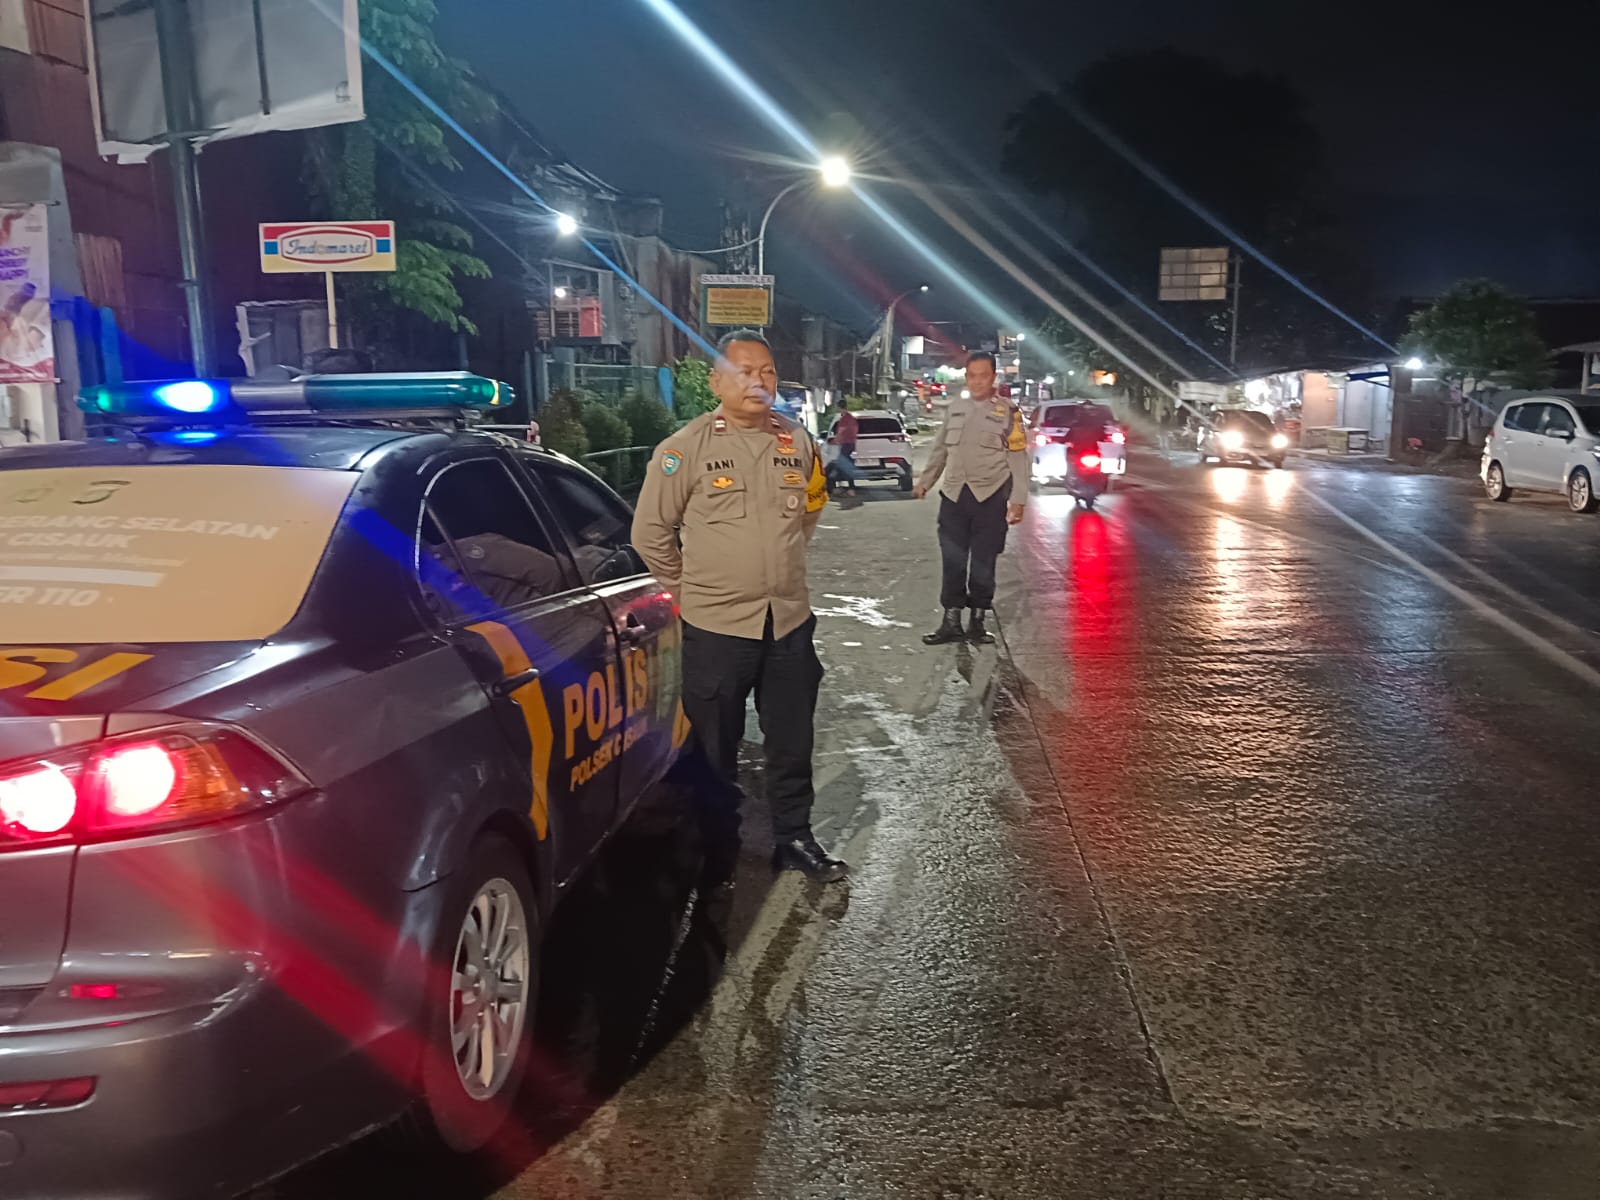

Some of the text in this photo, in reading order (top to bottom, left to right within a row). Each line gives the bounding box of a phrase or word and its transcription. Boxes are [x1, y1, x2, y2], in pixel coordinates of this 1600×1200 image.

[286, 239, 368, 256] Indomaret
[706, 459, 735, 471] BANI
[121, 517, 281, 540] SELATAN
[7, 533, 138, 548] CISAUK
[37, 588, 100, 607] 110
